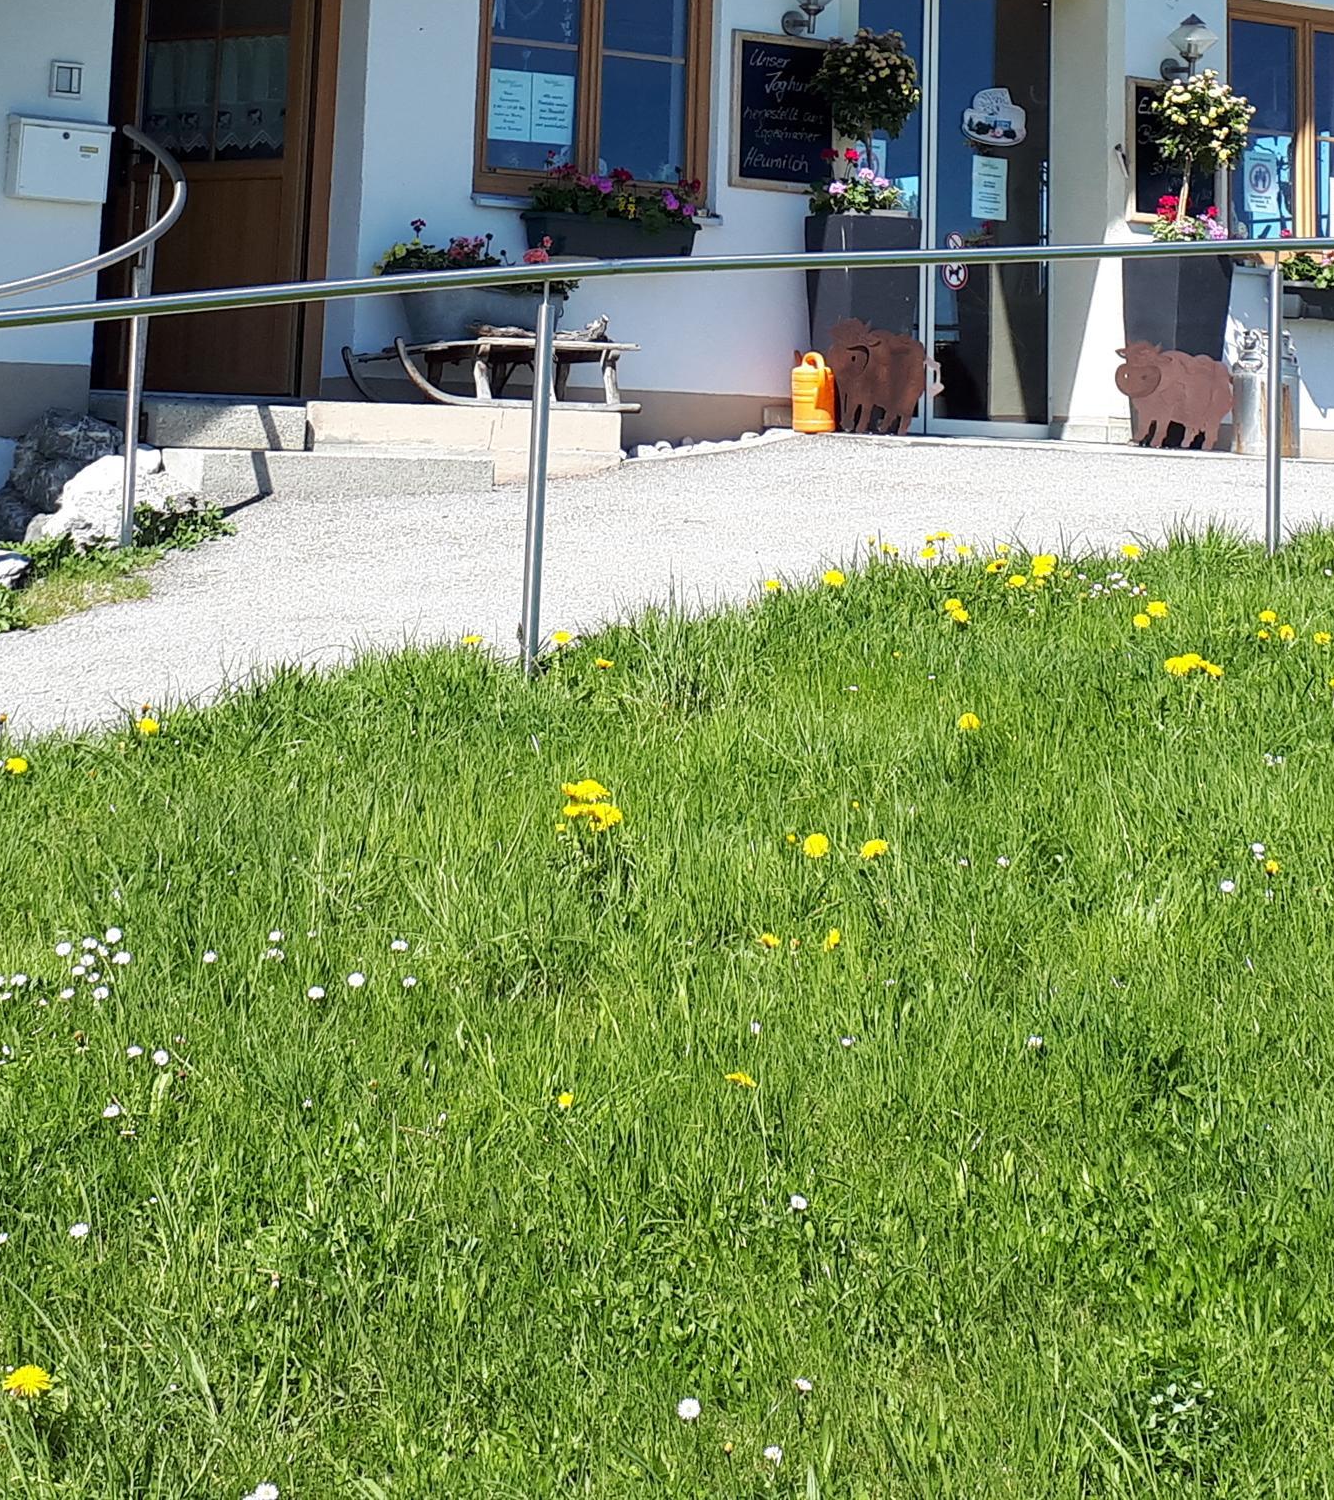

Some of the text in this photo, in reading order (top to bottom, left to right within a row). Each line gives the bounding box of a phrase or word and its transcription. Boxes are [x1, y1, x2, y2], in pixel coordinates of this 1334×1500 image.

[749, 48, 792, 68] Unser
[764, 71, 814, 103] Joghur
[743, 146, 809, 174] Heumilch
